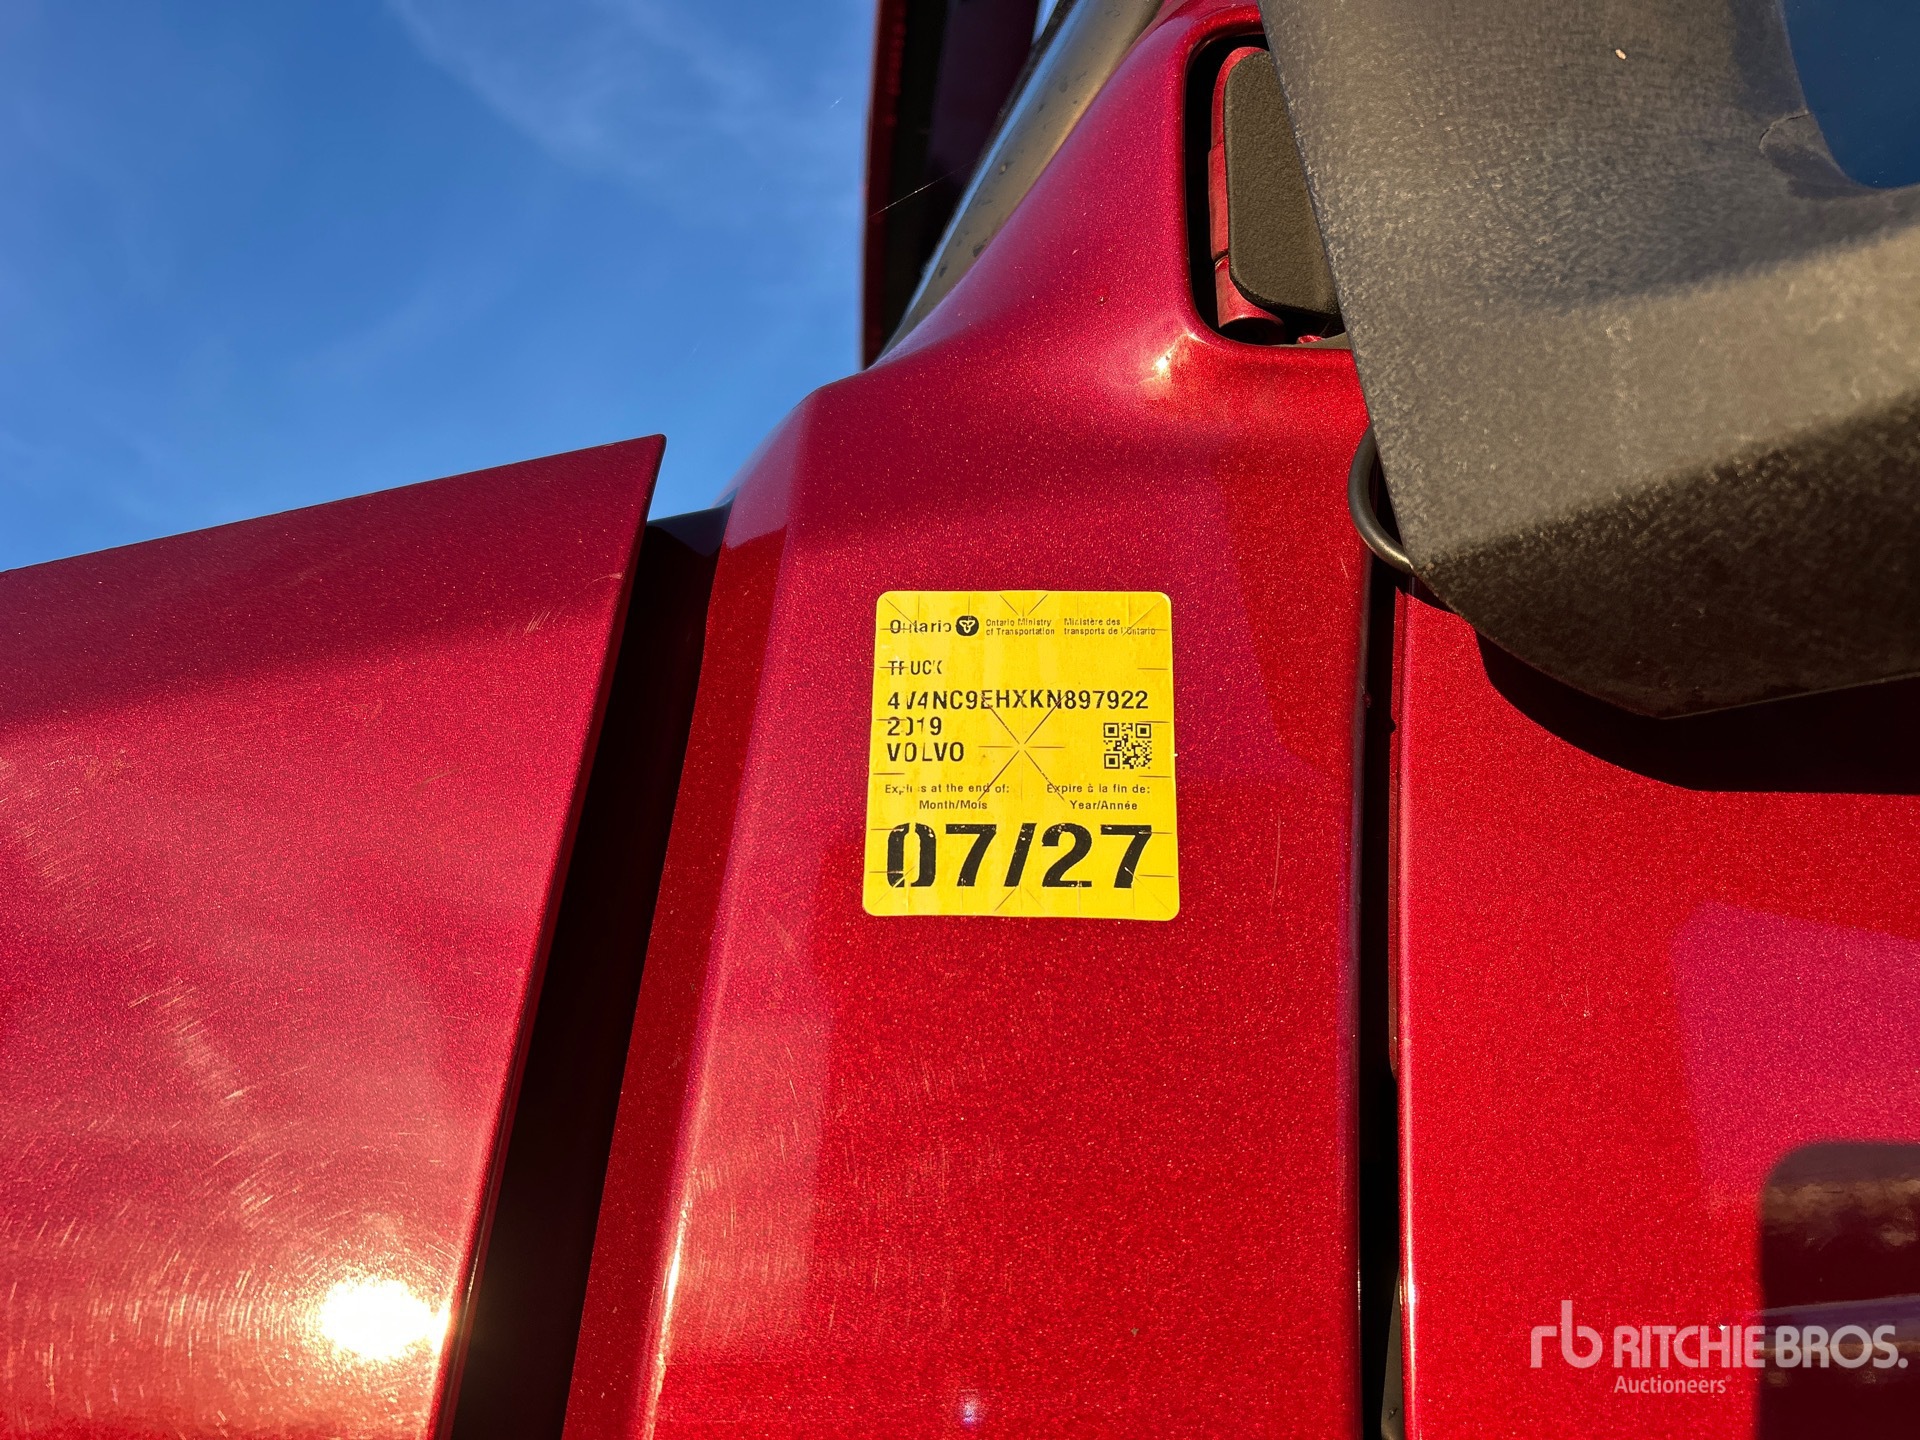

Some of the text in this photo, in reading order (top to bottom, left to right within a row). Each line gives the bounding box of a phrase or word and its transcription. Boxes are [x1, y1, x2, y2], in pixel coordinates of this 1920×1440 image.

[985, 617, 1052, 627] Ontario Ministry
[1106, 617, 1120, 626] des
[985, 627, 1055, 637] of Transportation
[1063, 627, 1105, 636] transports
[1108, 627, 1118, 635] de
[887, 689, 1149, 710] 4V4NC9EHXKN897922
[886, 741, 965, 762] VOLVO
[931, 783, 942, 793] at
[946, 783, 964, 793] the
[968, 782, 990, 793] end
[994, 783, 1010, 794] of:
[1046, 783, 1083, 795] Expire
[1099, 783, 1108, 793] la
[1113, 783, 1128, 793] fin
[1132, 784, 1151, 794] de:
[919, 799, 988, 810] Month/Mois
[1069, 799, 1138, 811] Year/Année
[886, 822, 1152, 889] 07/27
